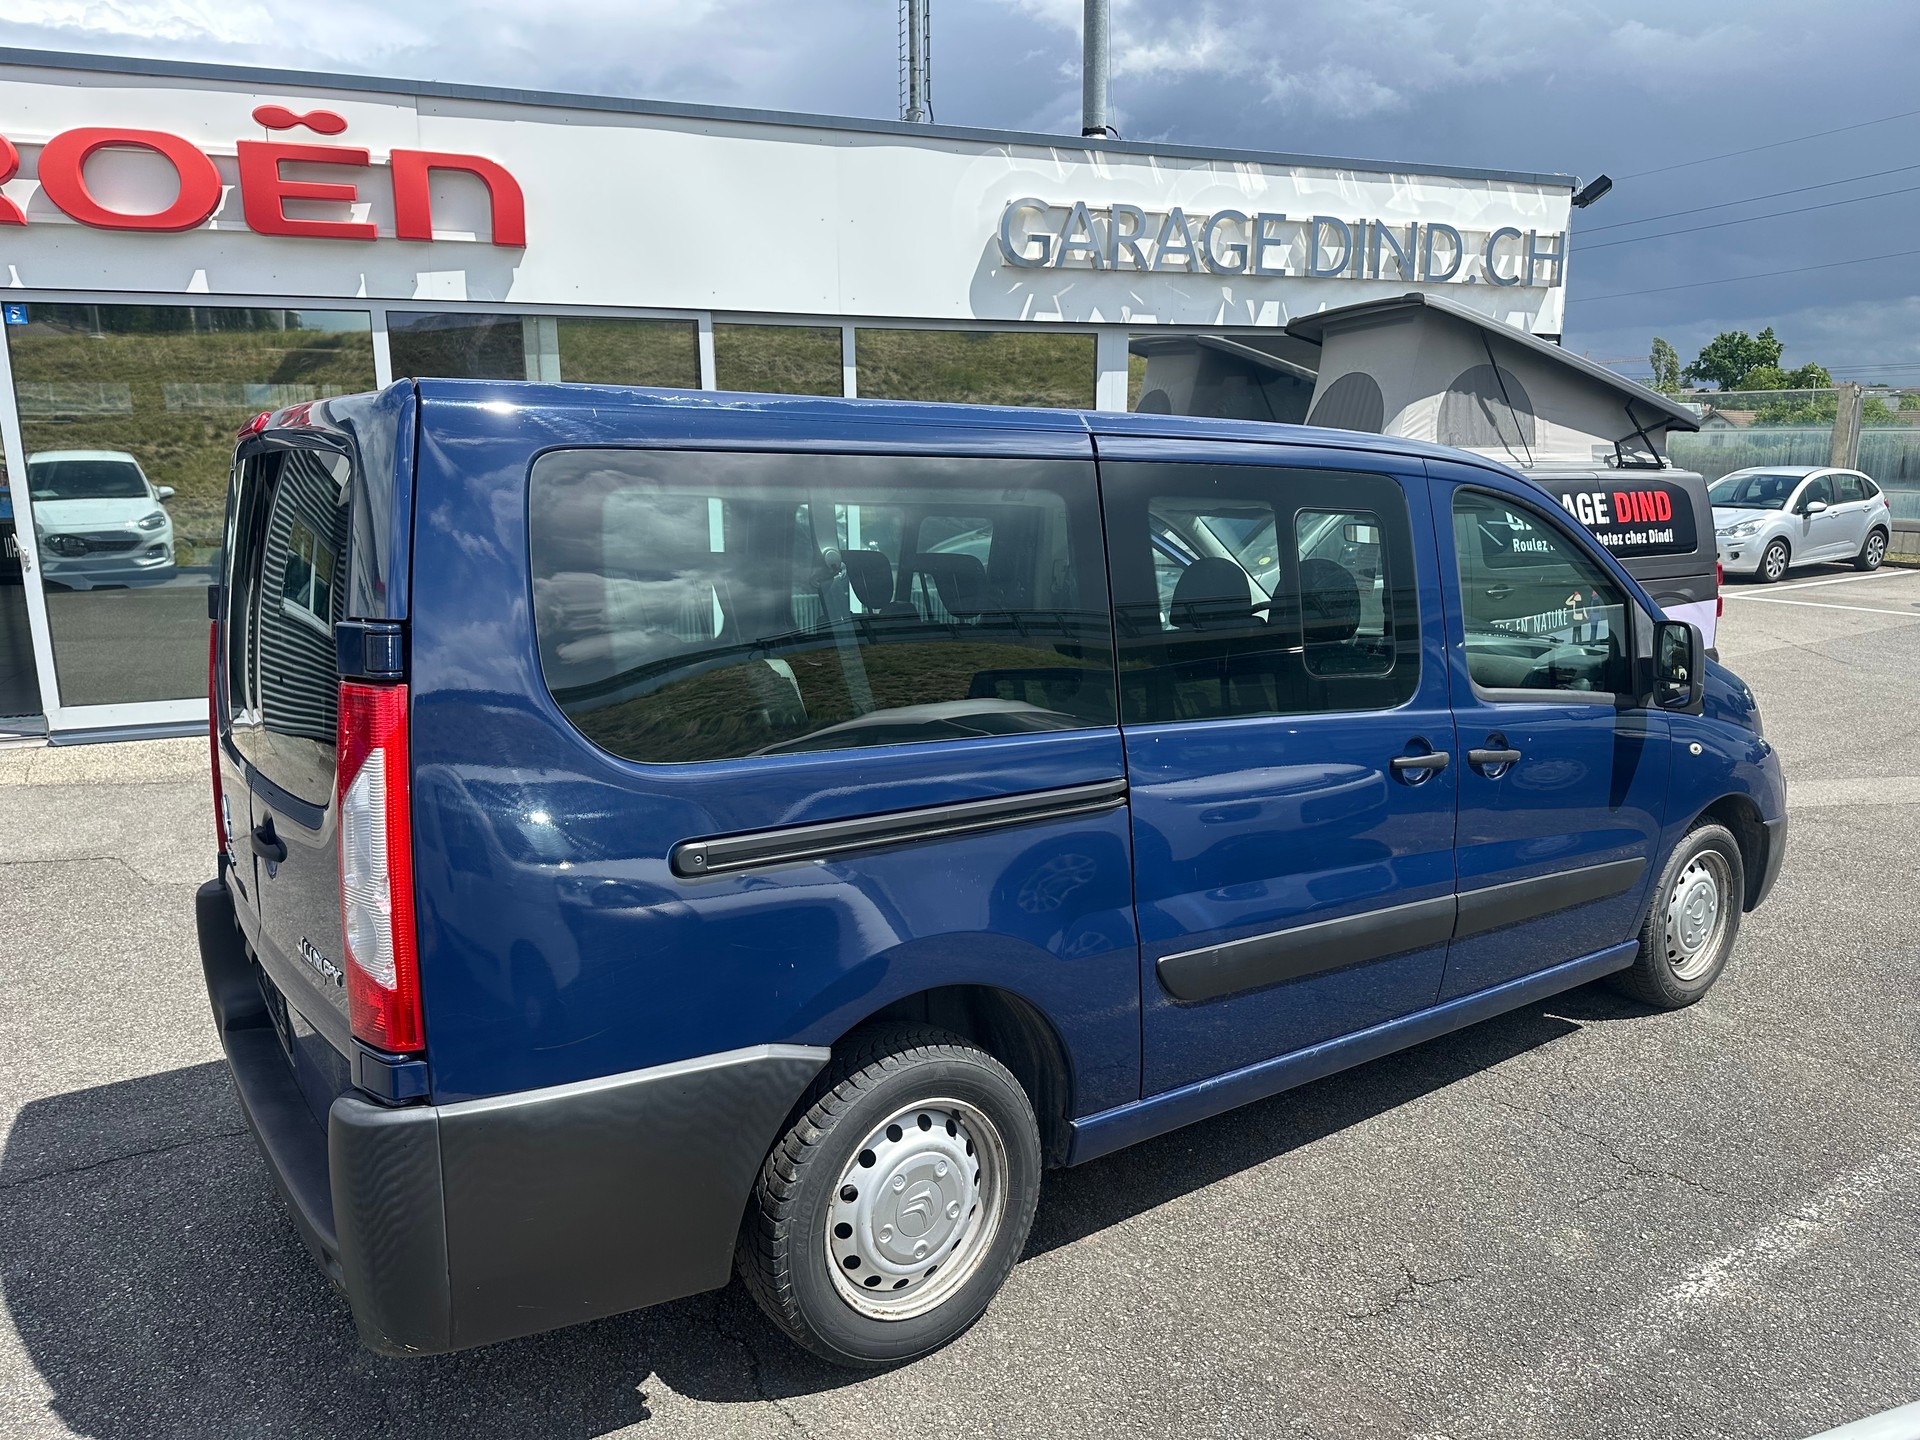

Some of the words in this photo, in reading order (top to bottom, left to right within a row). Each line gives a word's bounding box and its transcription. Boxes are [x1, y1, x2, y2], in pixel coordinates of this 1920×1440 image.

[0, 104, 527, 248] OËN
[998, 197, 1287, 276] GARAGE
[1307, 215, 1567, 288] DIND.CH
[1613, 490, 1672, 523] DIND
[1512, 538, 1548, 552] Roulez
[1625, 530, 1647, 545] chez
[1648, 528, 1674, 543] Dind!
[1516, 619, 1528, 632] EN
[1533, 607, 1568, 633] NATURE
